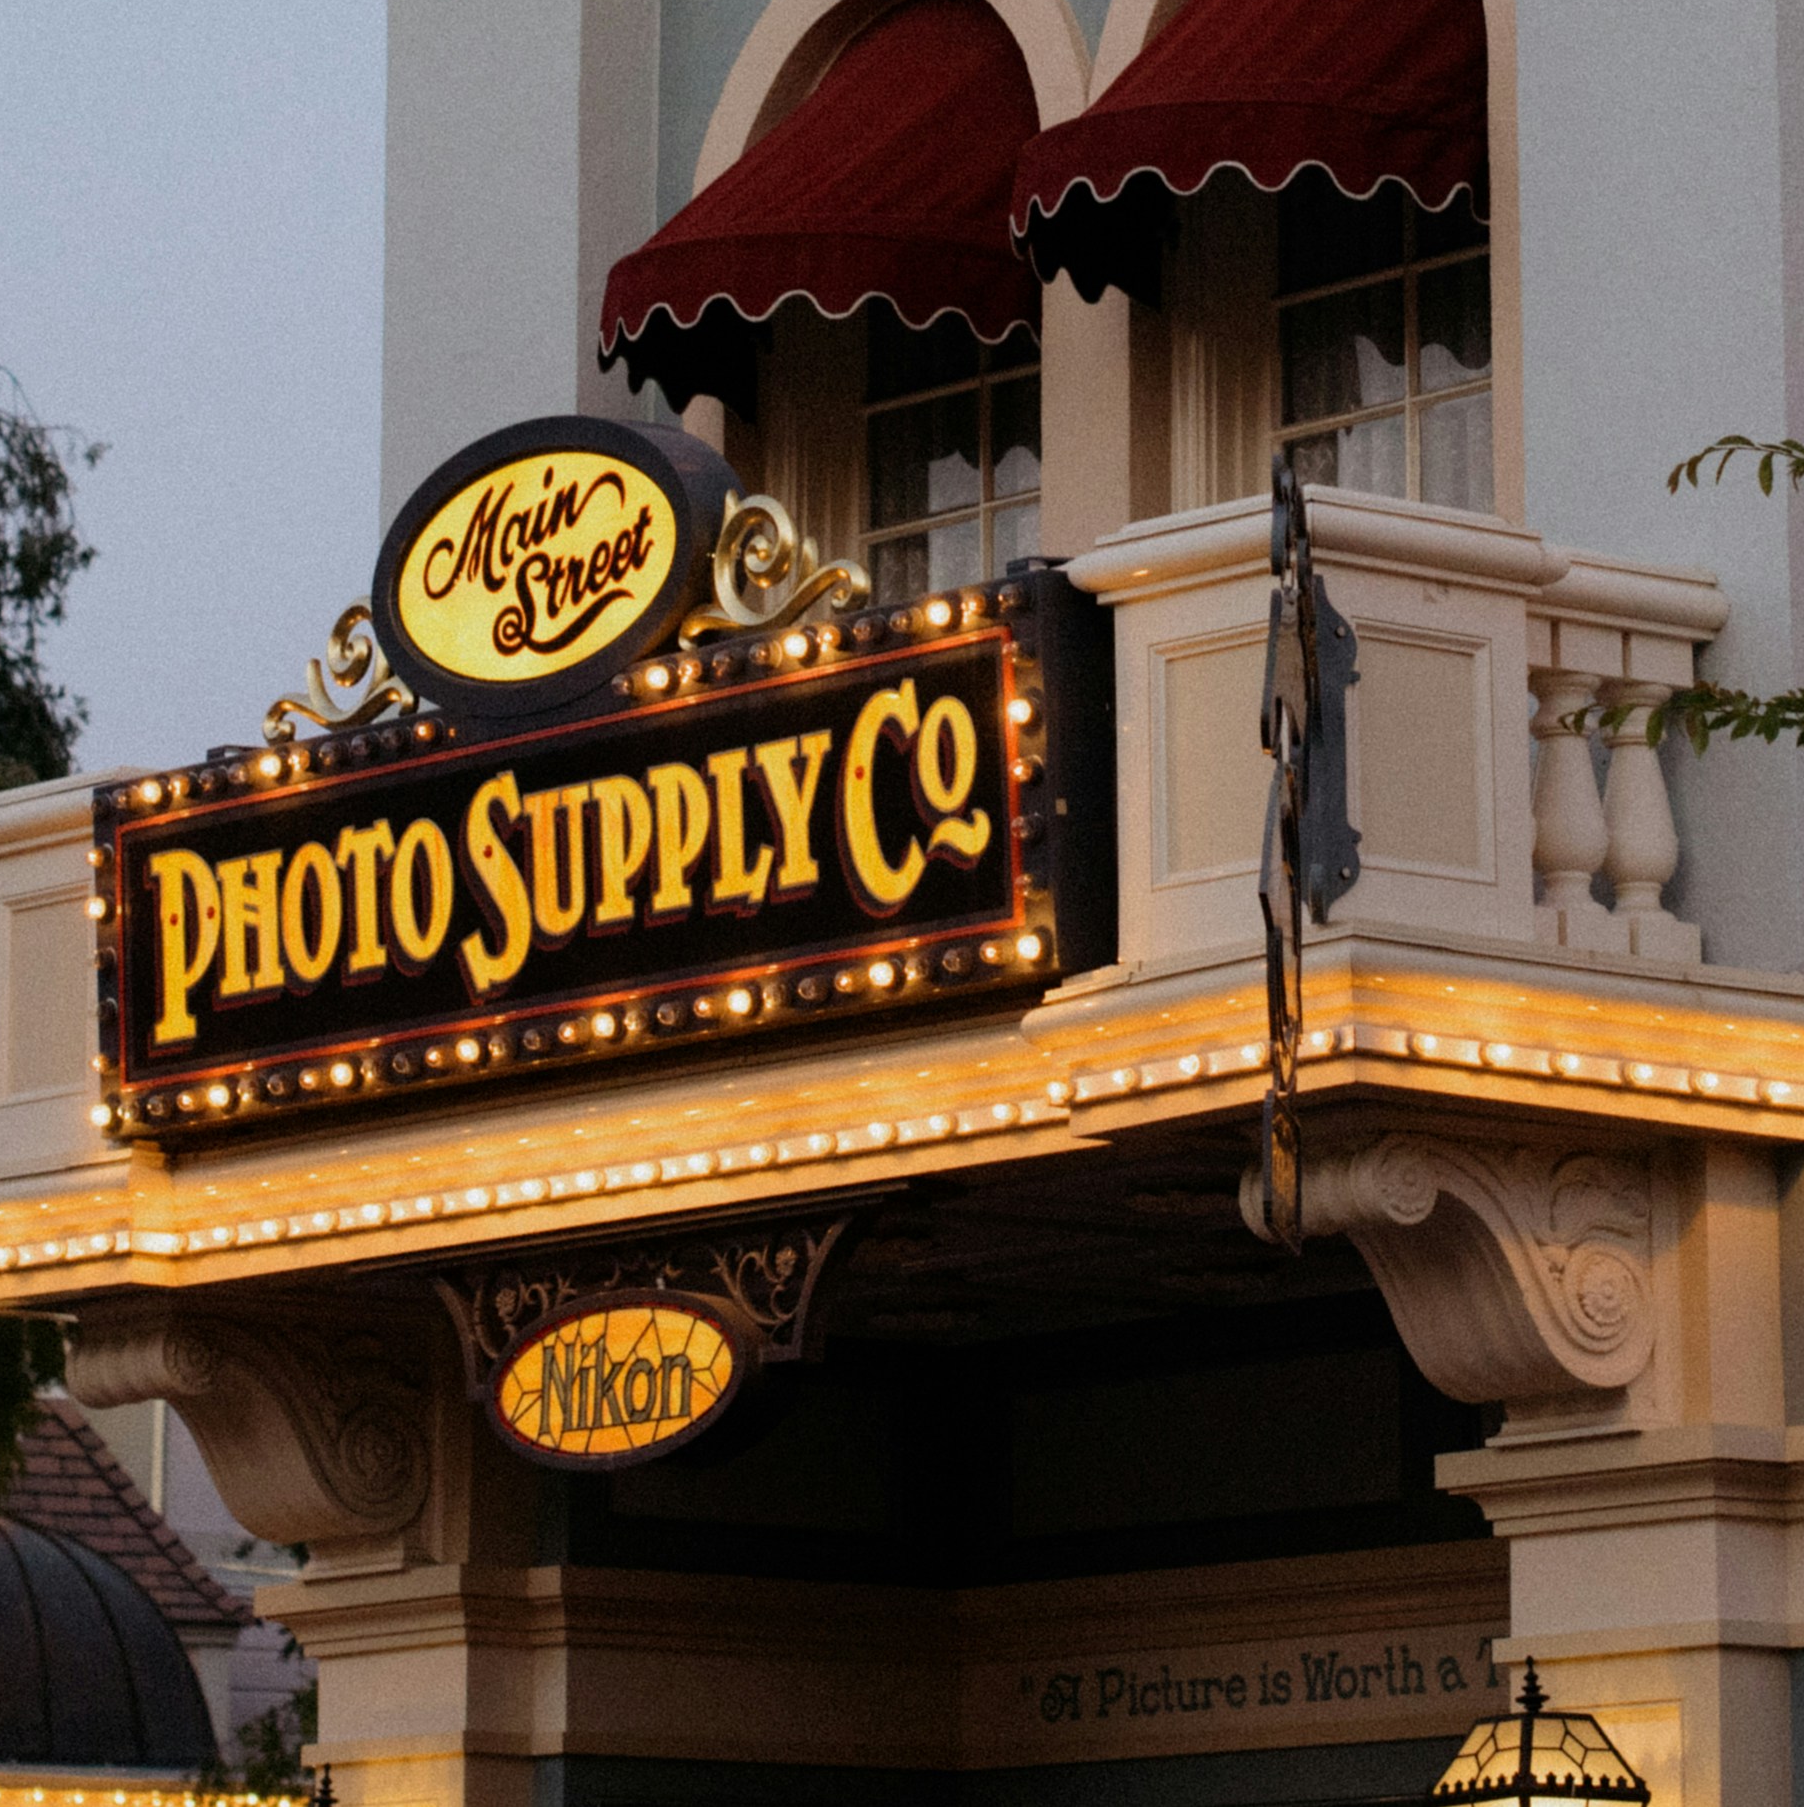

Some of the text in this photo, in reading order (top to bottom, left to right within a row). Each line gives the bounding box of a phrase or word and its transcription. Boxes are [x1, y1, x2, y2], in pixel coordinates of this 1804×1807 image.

[425, 468, 628, 600] Main
[492, 505, 654, 656] Street
[150, 817, 454, 1044] PHOTO
[460, 731, 833, 992] SUPPLY
[537, 1335, 692, 1435] Nikon
[1097, 1666, 1247, 1717] Picture
[1259, 1660, 1292, 1705] is
[1301, 1645, 1425, 1702] Worth
[1439, 1655, 1468, 1692] a
